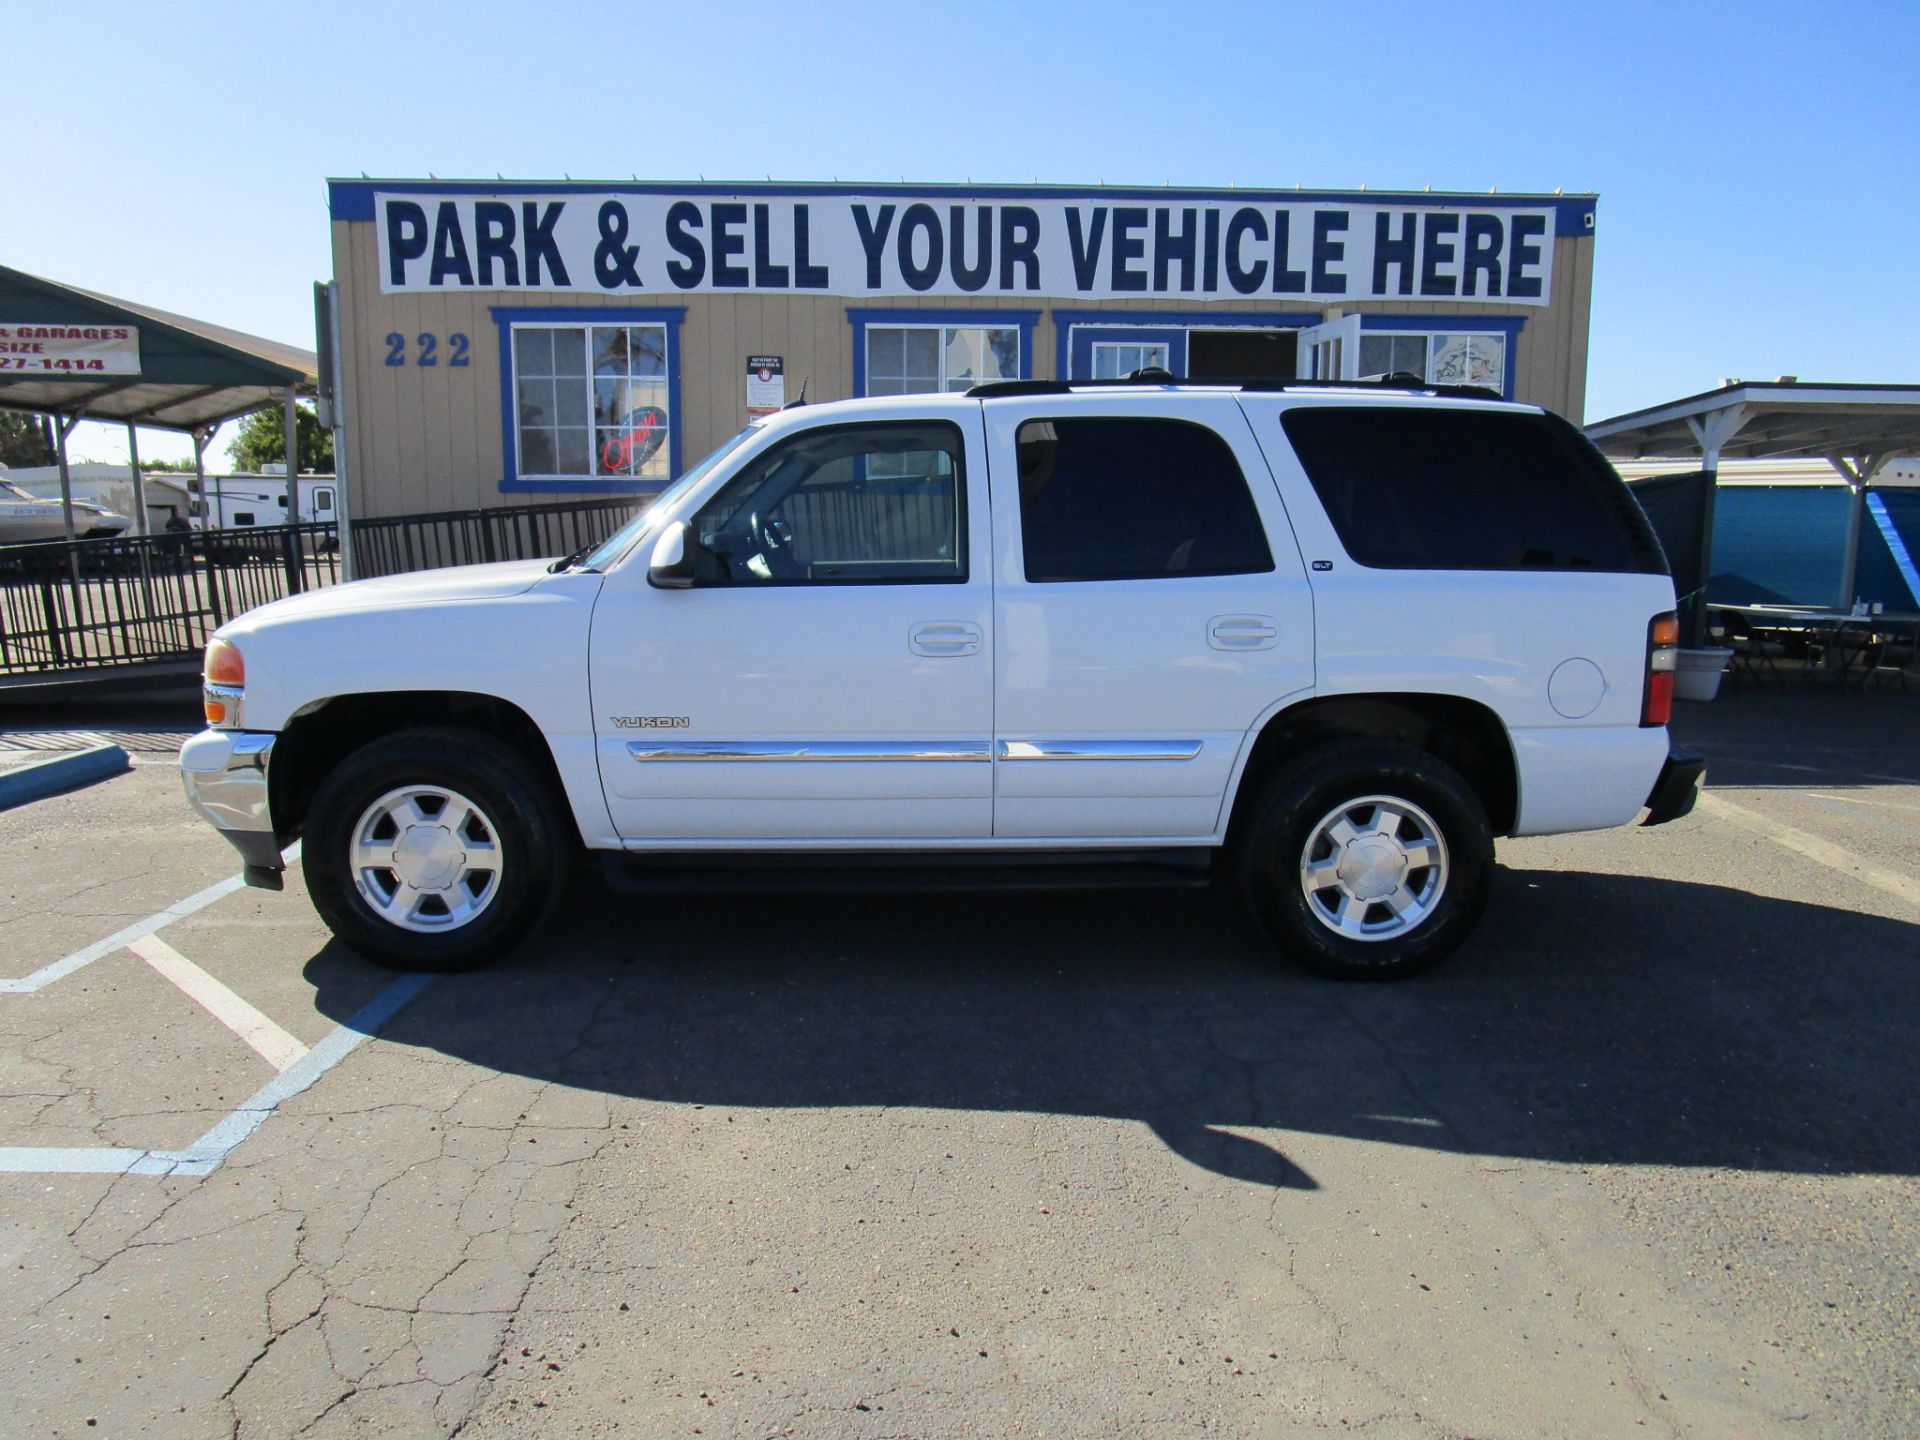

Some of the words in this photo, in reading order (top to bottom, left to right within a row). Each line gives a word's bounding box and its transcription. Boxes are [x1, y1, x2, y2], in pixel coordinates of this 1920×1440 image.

[386, 200, 571, 287] PARK
[594, 200, 643, 290] &
[666, 200, 828, 290] SELL
[851, 203, 1040, 292] YOUR
[1065, 206, 1349, 295] VEHICLE
[1372, 211, 1545, 298] HERE
[17, 327, 128, 339] GARAGES
[0, 342, 44, 354] SIZE
[385, 332, 468, 366] 222
[610, 716, 690, 728] YUKON
